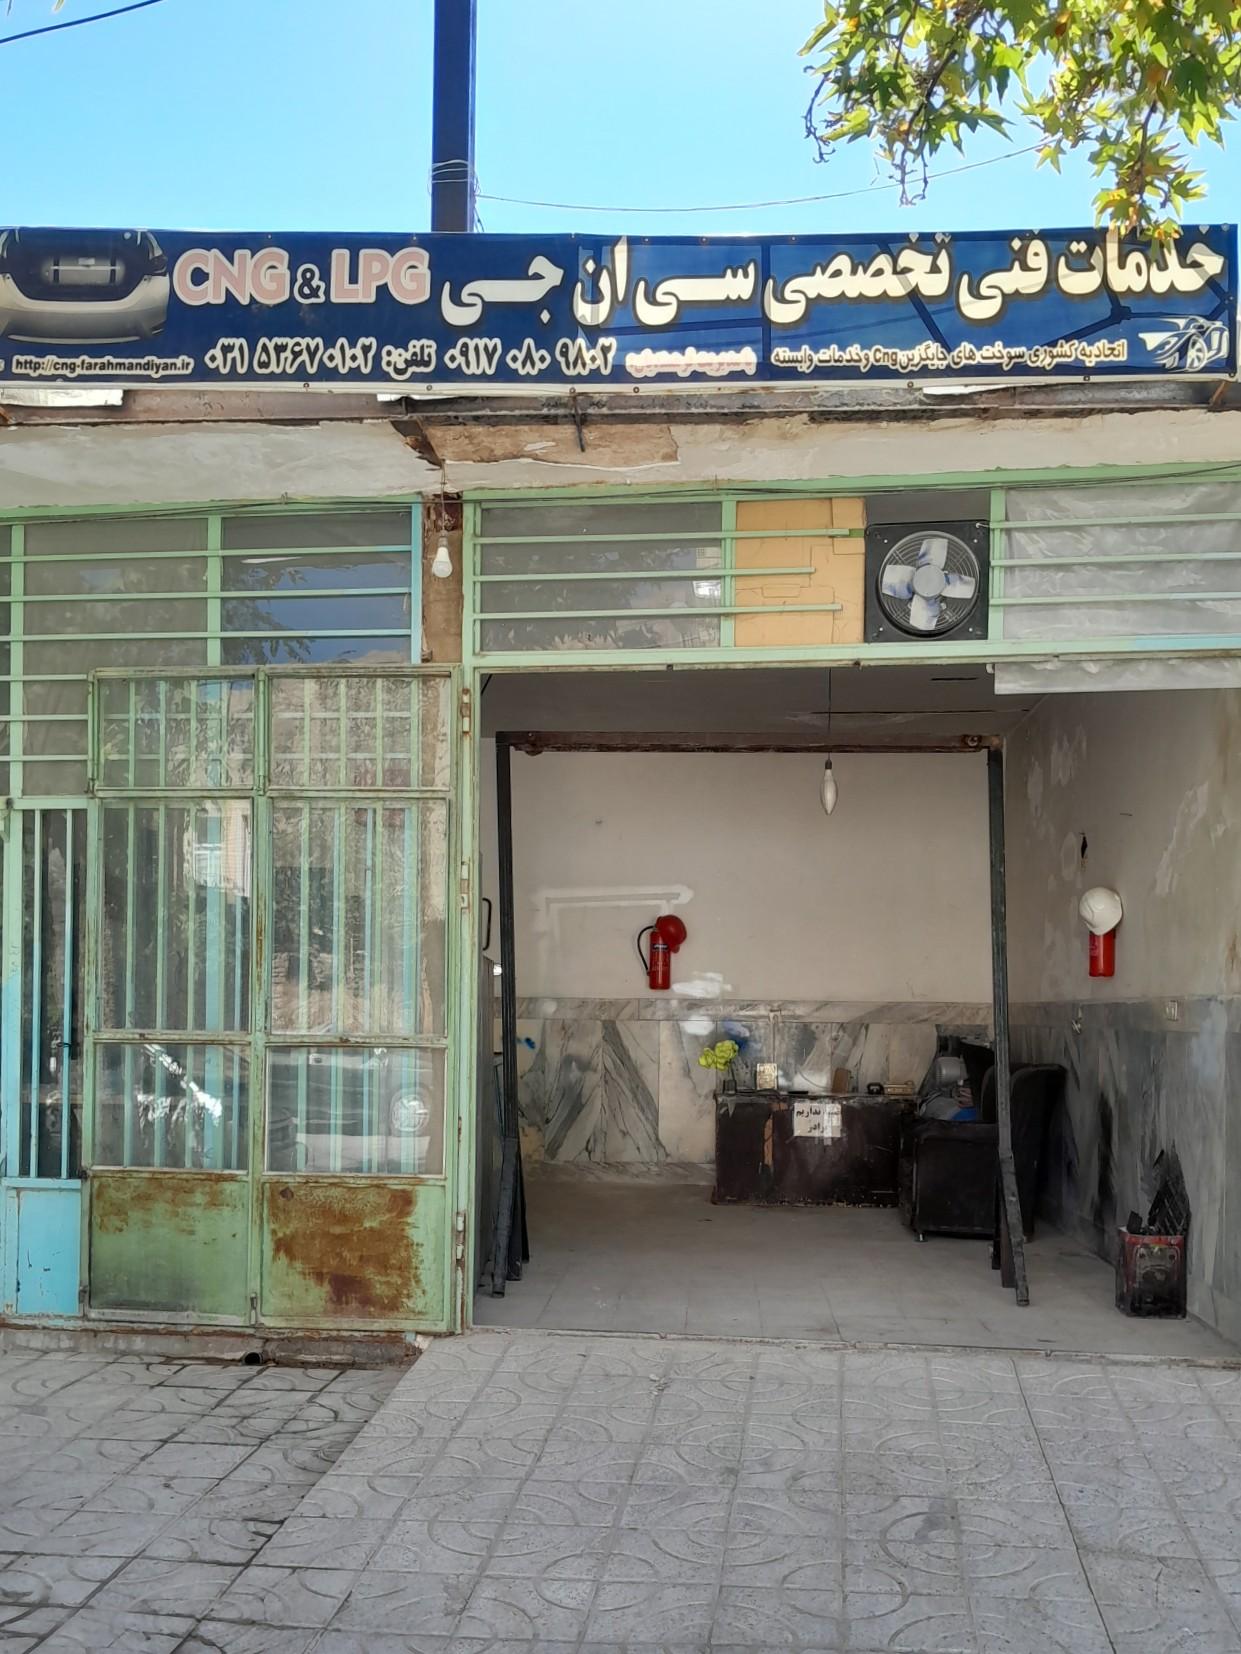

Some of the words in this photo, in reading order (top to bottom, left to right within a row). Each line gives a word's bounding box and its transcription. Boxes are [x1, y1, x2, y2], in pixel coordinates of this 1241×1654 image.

[173, 247, 291, 306] CNG
[298, 267, 321, 299] &
[331, 247, 431, 306] LPG
[763, 231, 953, 325] تخصصی
[957, 234, 1049, 322] فنی
[1057, 232, 1226, 296] خدمات
[440, 255, 565, 327] جی
[572, 235, 629, 327] ان
[636, 260, 756, 326] سی
[208, 341, 246, 371] ۰۳۱
[447, 340, 500, 371] ۰۹۱۷
[508, 341, 547, 371] ۰۸۰
[558, 341, 614, 372] ۹۸۰۲
[772, 350, 814, 371] وابسته
[872, 350, 898, 367] Cng
[900, 344, 949, 371] جایگزین
[950, 345, 977, 367] های
[979, 346, 1026, 369] سوخت
[1027, 342, 1077, 371] کشوری
[1078, 341, 1126, 365] اتحادیه
